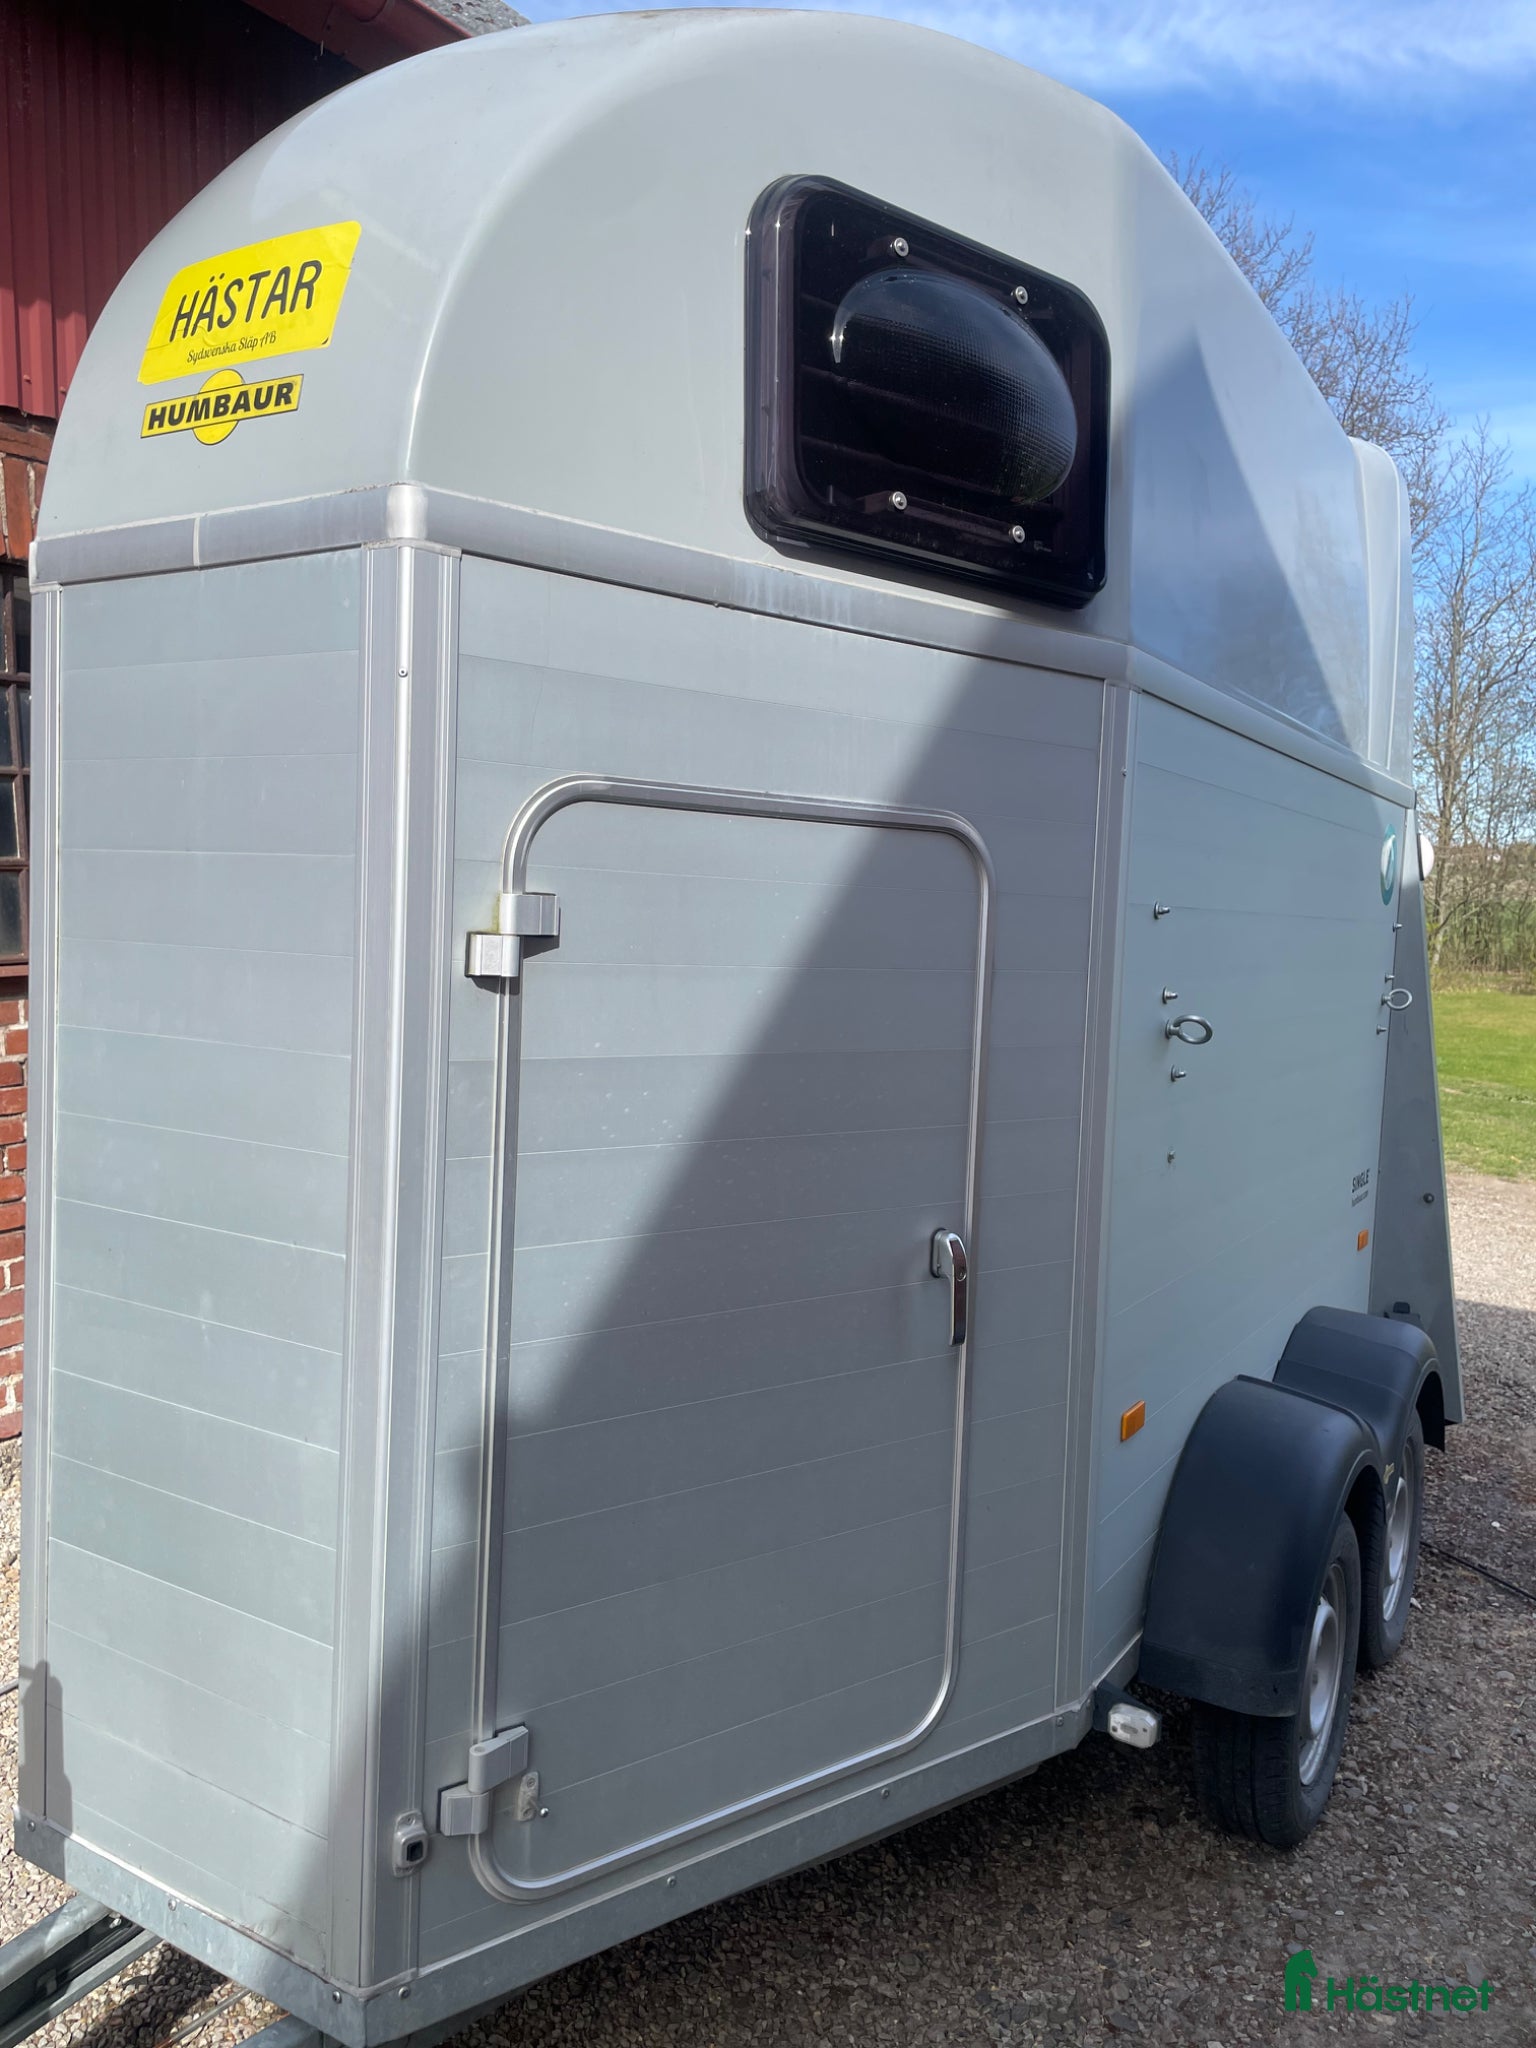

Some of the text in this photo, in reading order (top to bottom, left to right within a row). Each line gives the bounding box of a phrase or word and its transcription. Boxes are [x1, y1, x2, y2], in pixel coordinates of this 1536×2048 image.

[169, 259, 322, 342] HÄSTAR
[187, 330, 277, 365] Sydsvenska Släp AB
[147, 381, 295, 430] HUMBAUR
